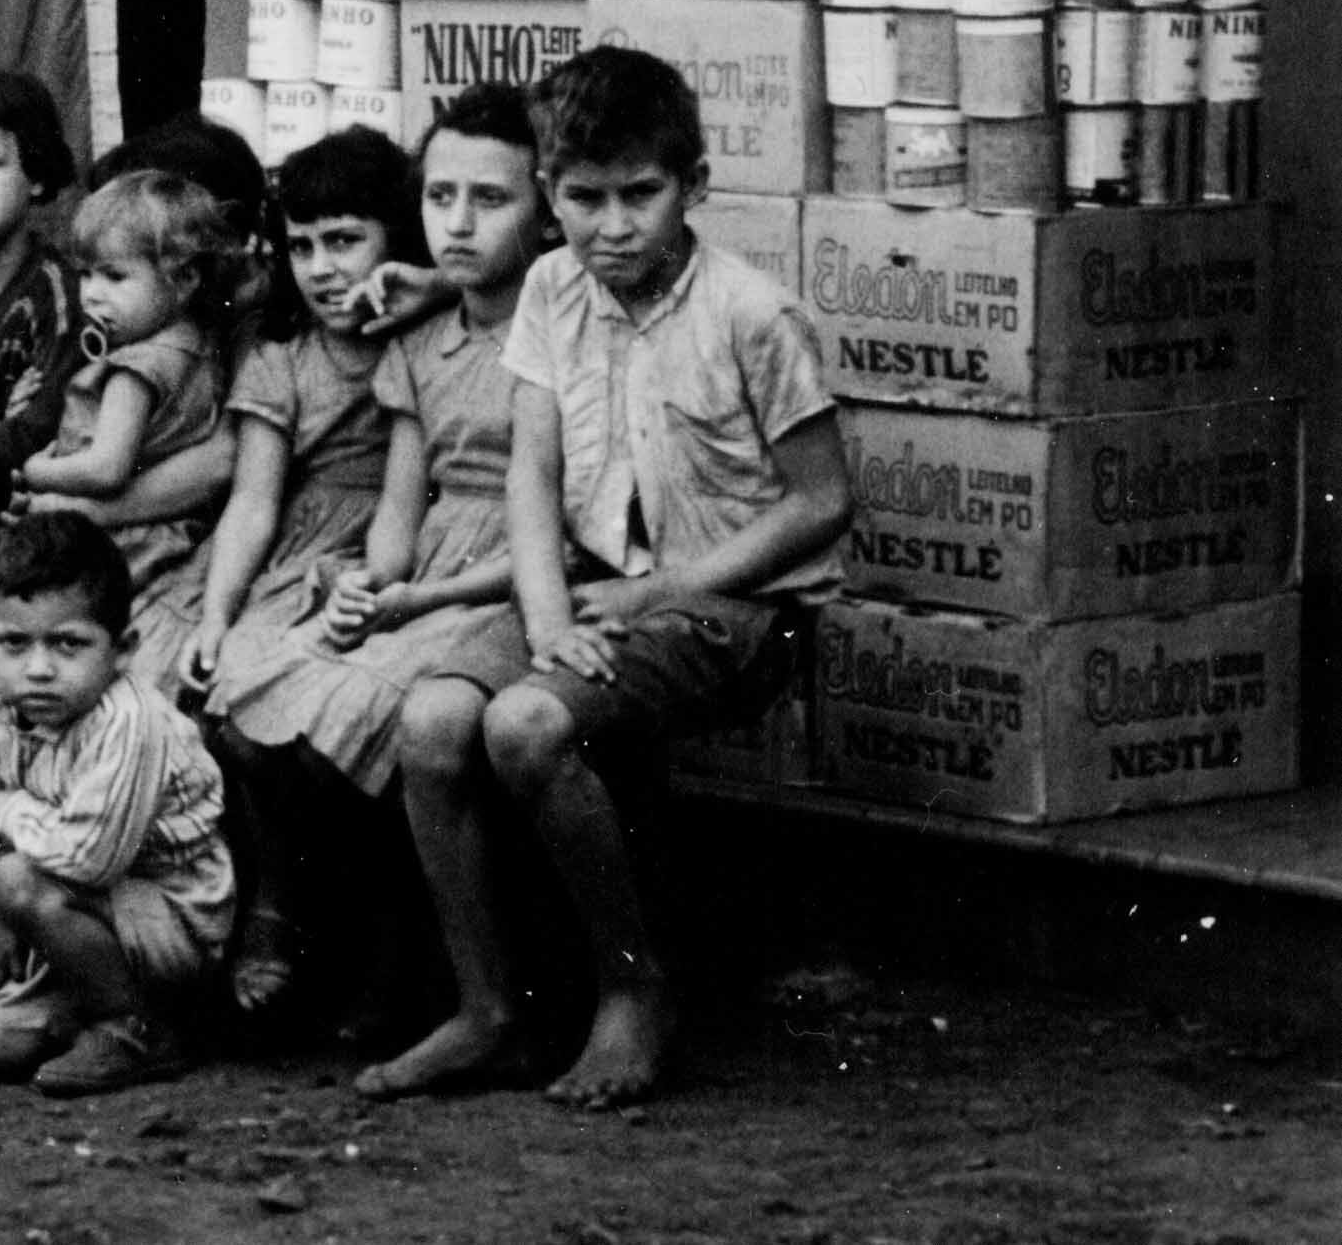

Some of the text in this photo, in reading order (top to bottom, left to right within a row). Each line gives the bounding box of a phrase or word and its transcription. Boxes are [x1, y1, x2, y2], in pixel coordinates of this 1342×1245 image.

[954, 300, 981, 328] EM
[838, 333, 990, 383] NESTLÉ
[846, 436, 965, 522] ledon
[851, 536, 1003, 582] NESTLÉ
